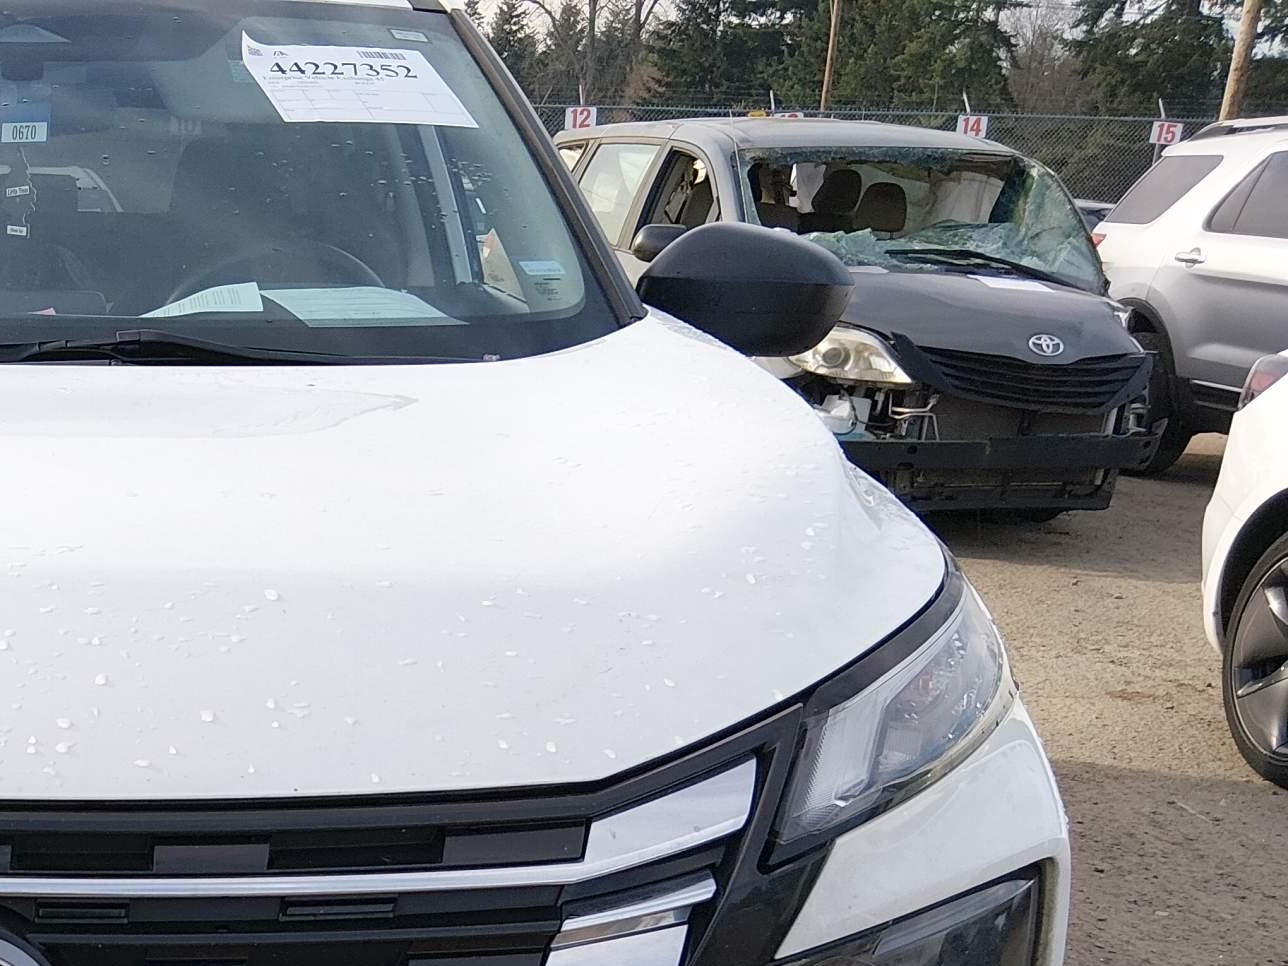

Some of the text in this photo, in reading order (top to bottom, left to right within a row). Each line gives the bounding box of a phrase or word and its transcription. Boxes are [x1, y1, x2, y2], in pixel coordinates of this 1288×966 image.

[270, 62, 418, 79] 44227352
[571, 108, 591, 129] 12
[962, 117, 982, 137] 14
[12, 125, 37, 140] 0670
[1156, 123, 1178, 143] 15
